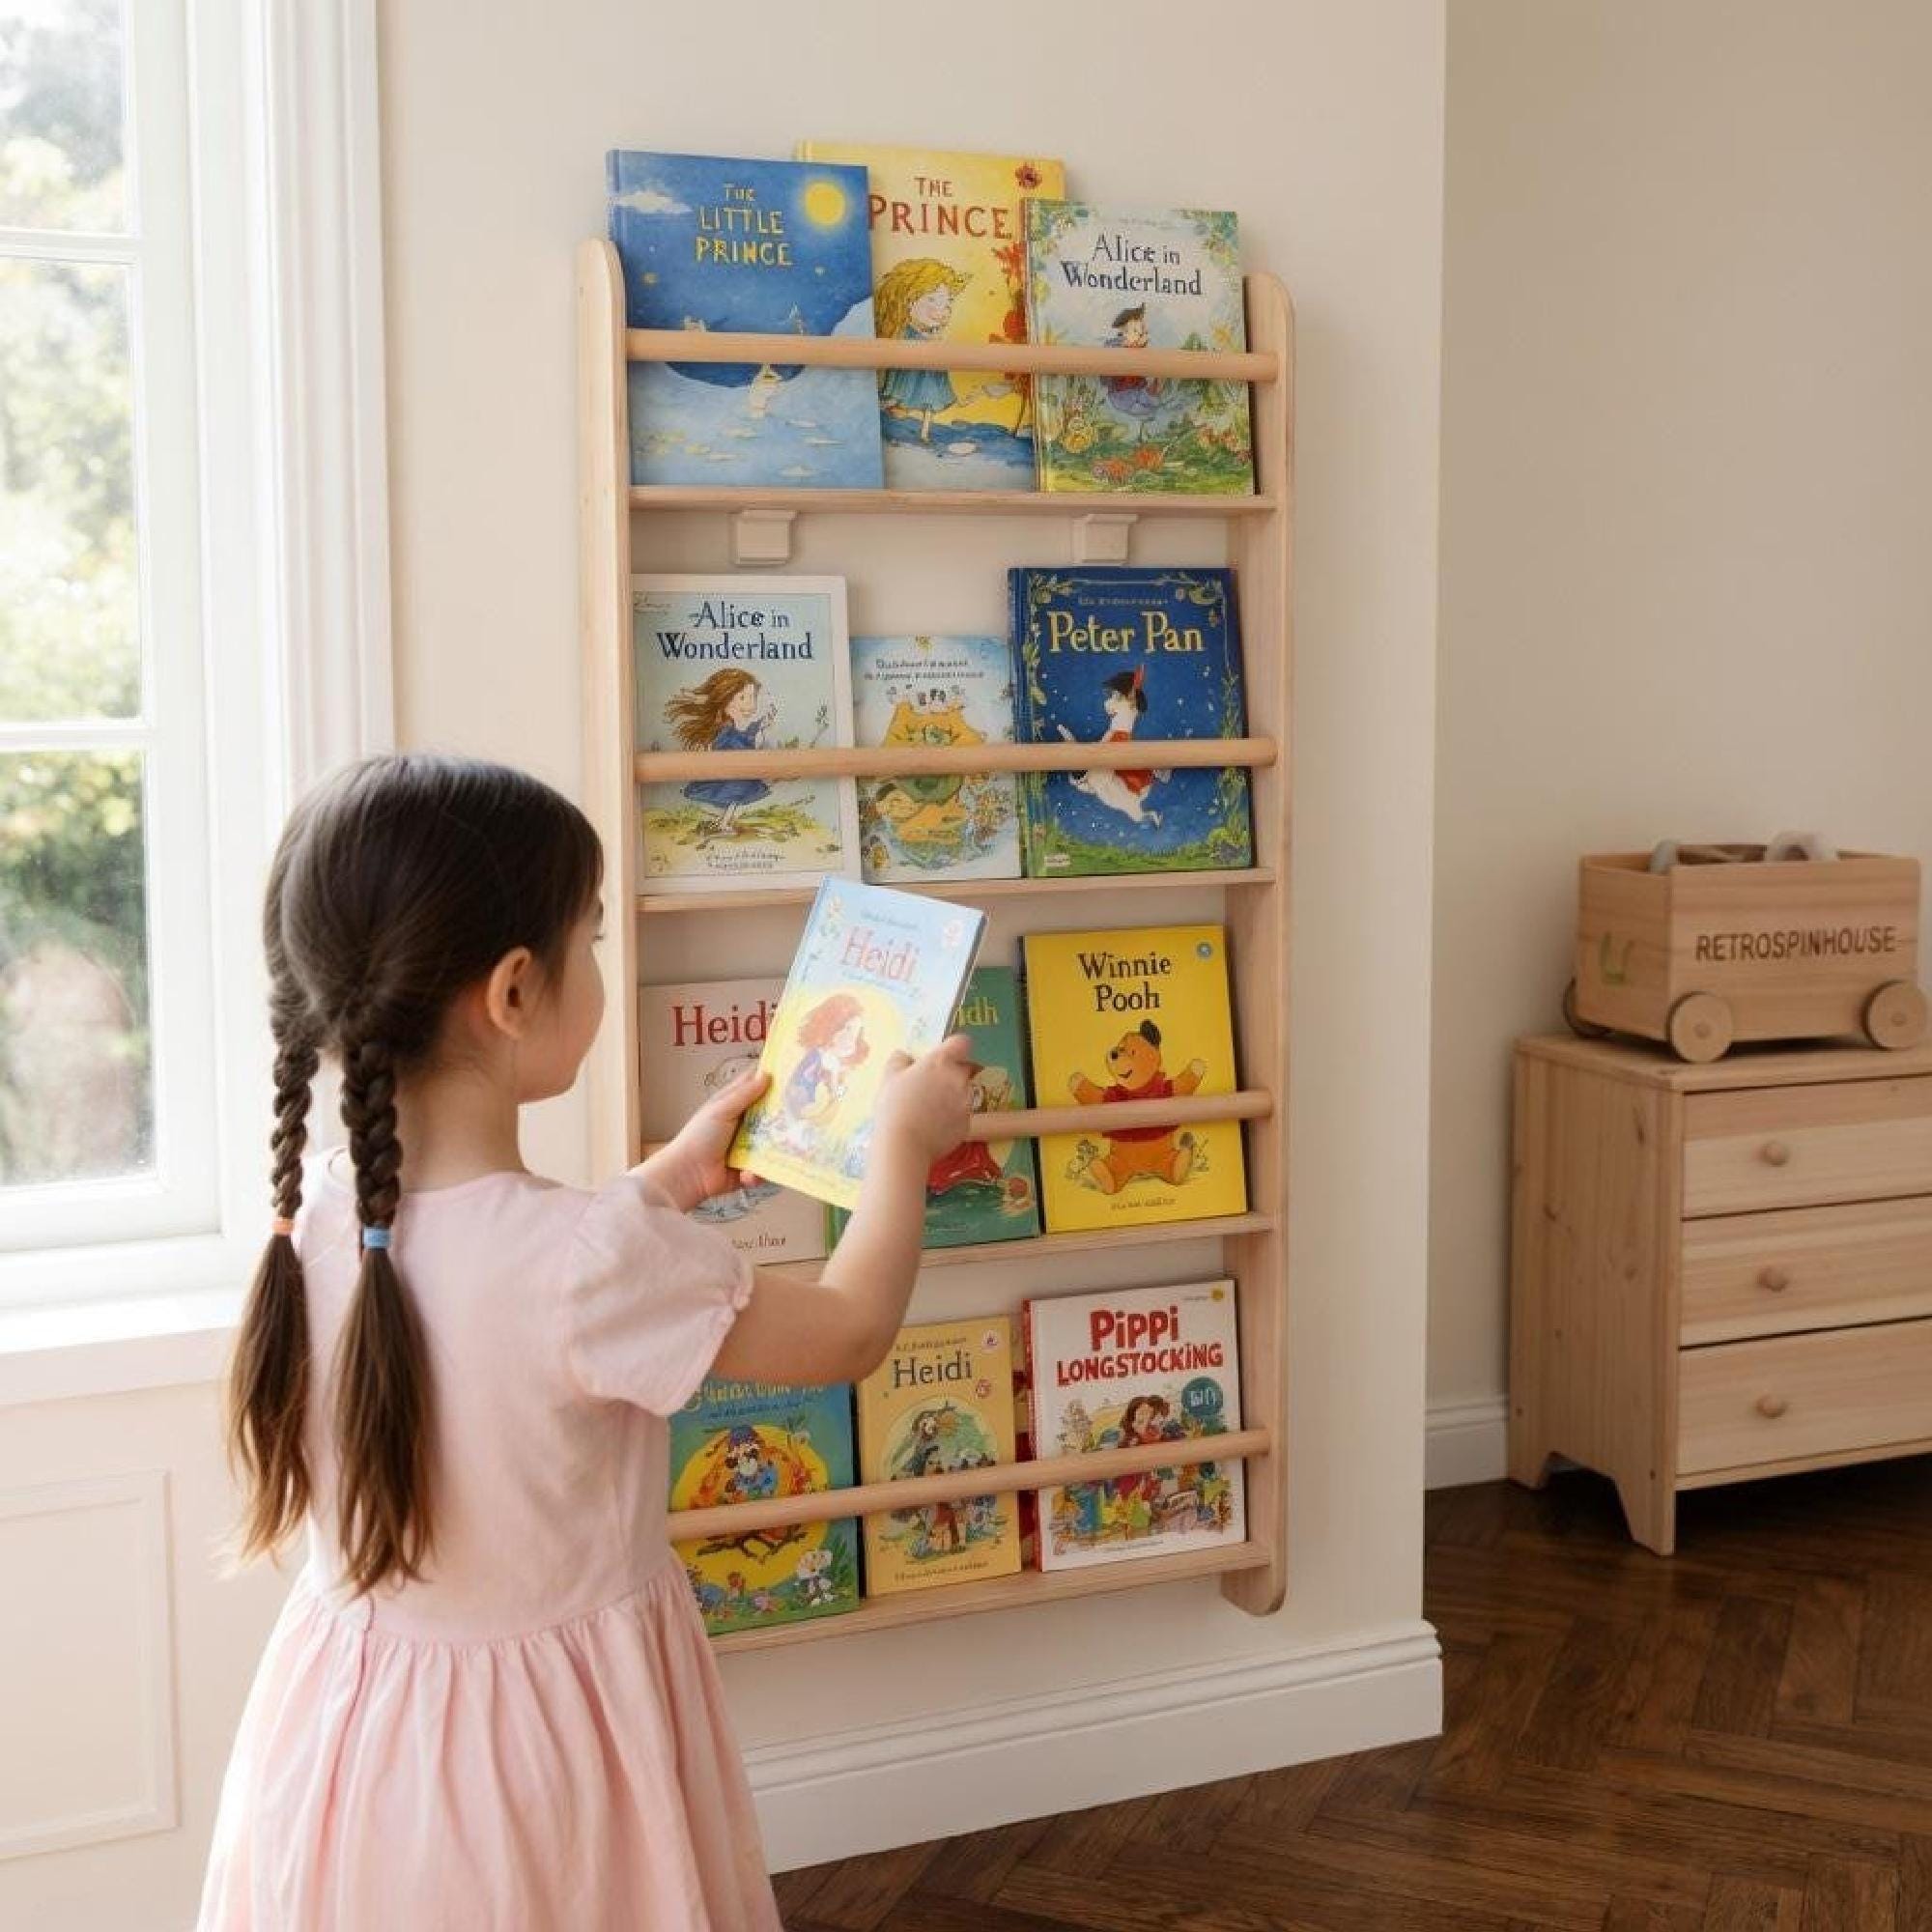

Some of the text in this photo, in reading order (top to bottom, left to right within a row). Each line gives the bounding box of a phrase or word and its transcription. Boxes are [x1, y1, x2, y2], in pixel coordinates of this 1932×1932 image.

[914, 177, 953, 197] THE
[698, 205, 784, 235] LITTLE
[868, 194, 1013, 241] PRINCE
[696, 236, 794, 267] PRINCE
[1093, 232, 1181, 266] Alice in
[1060, 260, 1203, 296] Wonderland
[688, 600, 766, 630] Alice
[771, 609, 790, 629] in
[656, 631, 814, 661] Wonderland
[1046, 611, 1207, 655] Peter Pan
[839, 924, 922, 984] Heidi
[1695, 924, 1896, 961] RETROSPINHOUSE
[1076, 951, 1172, 980] Winnie
[1094, 980, 1161, 1013] Pooh
[892, 1350, 973, 1389] Heidi
[1056, 1342, 1224, 1387] LONGSTOCKING
